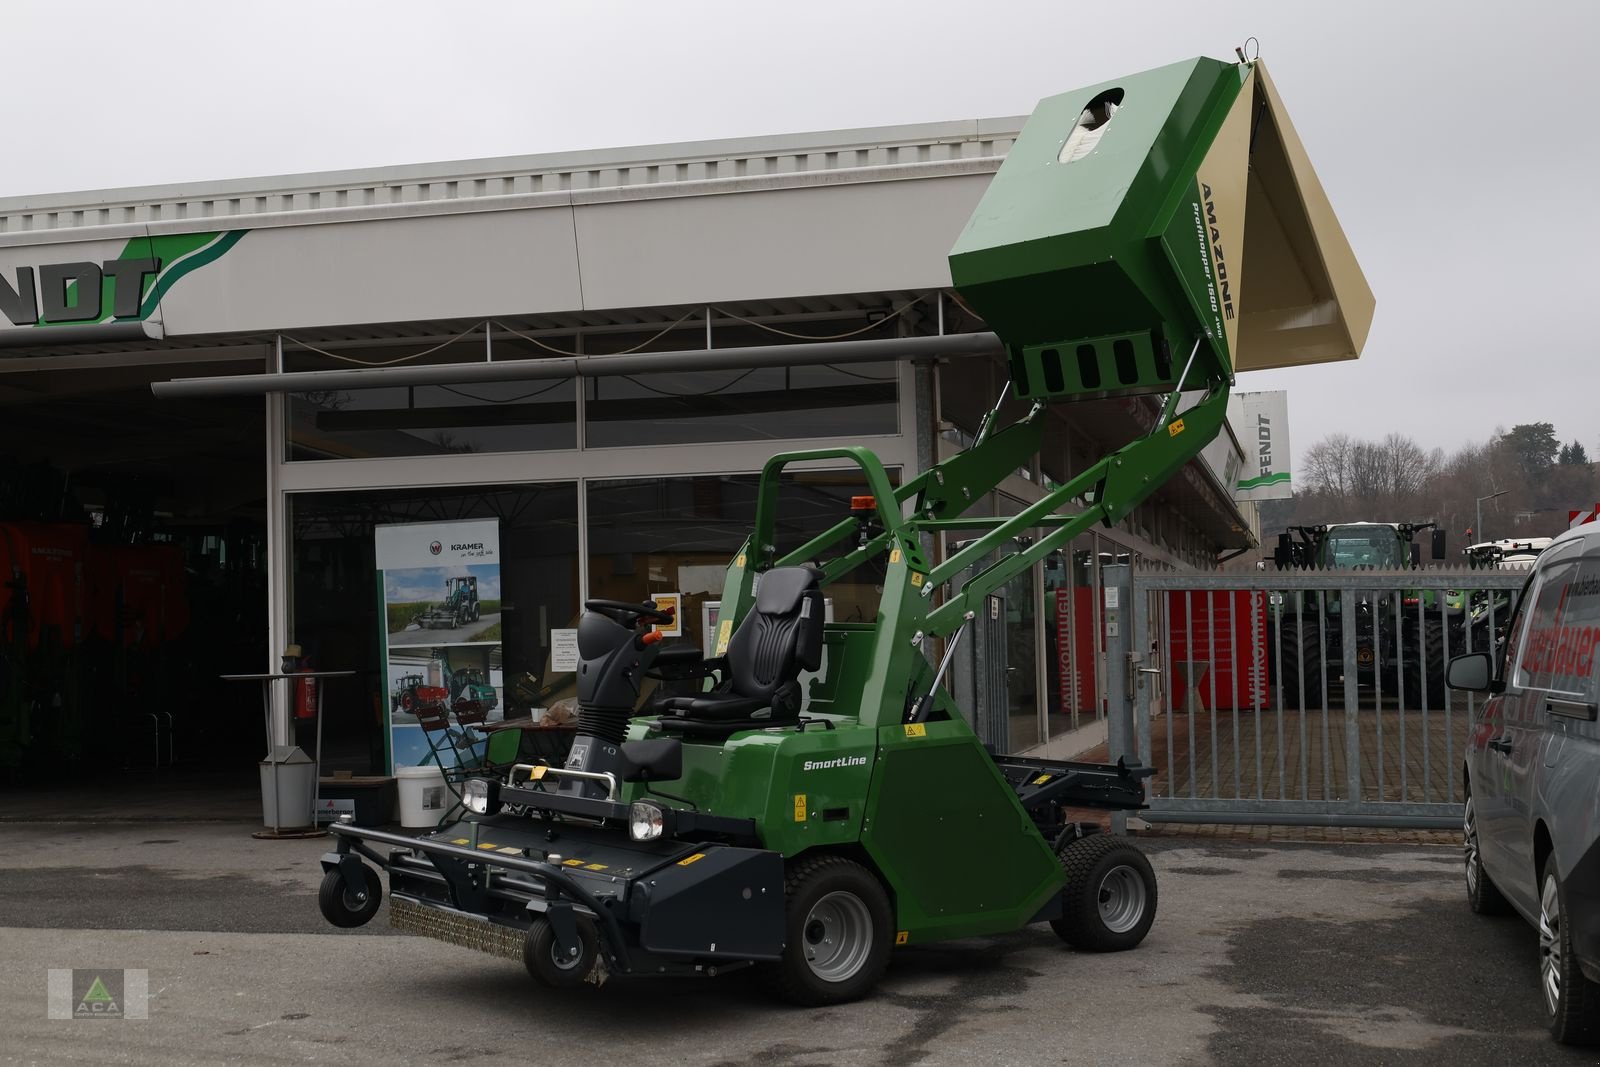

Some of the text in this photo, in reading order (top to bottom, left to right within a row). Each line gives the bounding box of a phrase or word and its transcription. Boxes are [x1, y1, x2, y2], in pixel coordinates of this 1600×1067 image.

[1201, 182, 1235, 321] AMAZONE
[1207, 281, 1218, 312] 1500
[1258, 413, 1273, 479] FENDT
[450, 543, 484, 551] KRAMER
[803, 756, 867, 771] SmartLine
